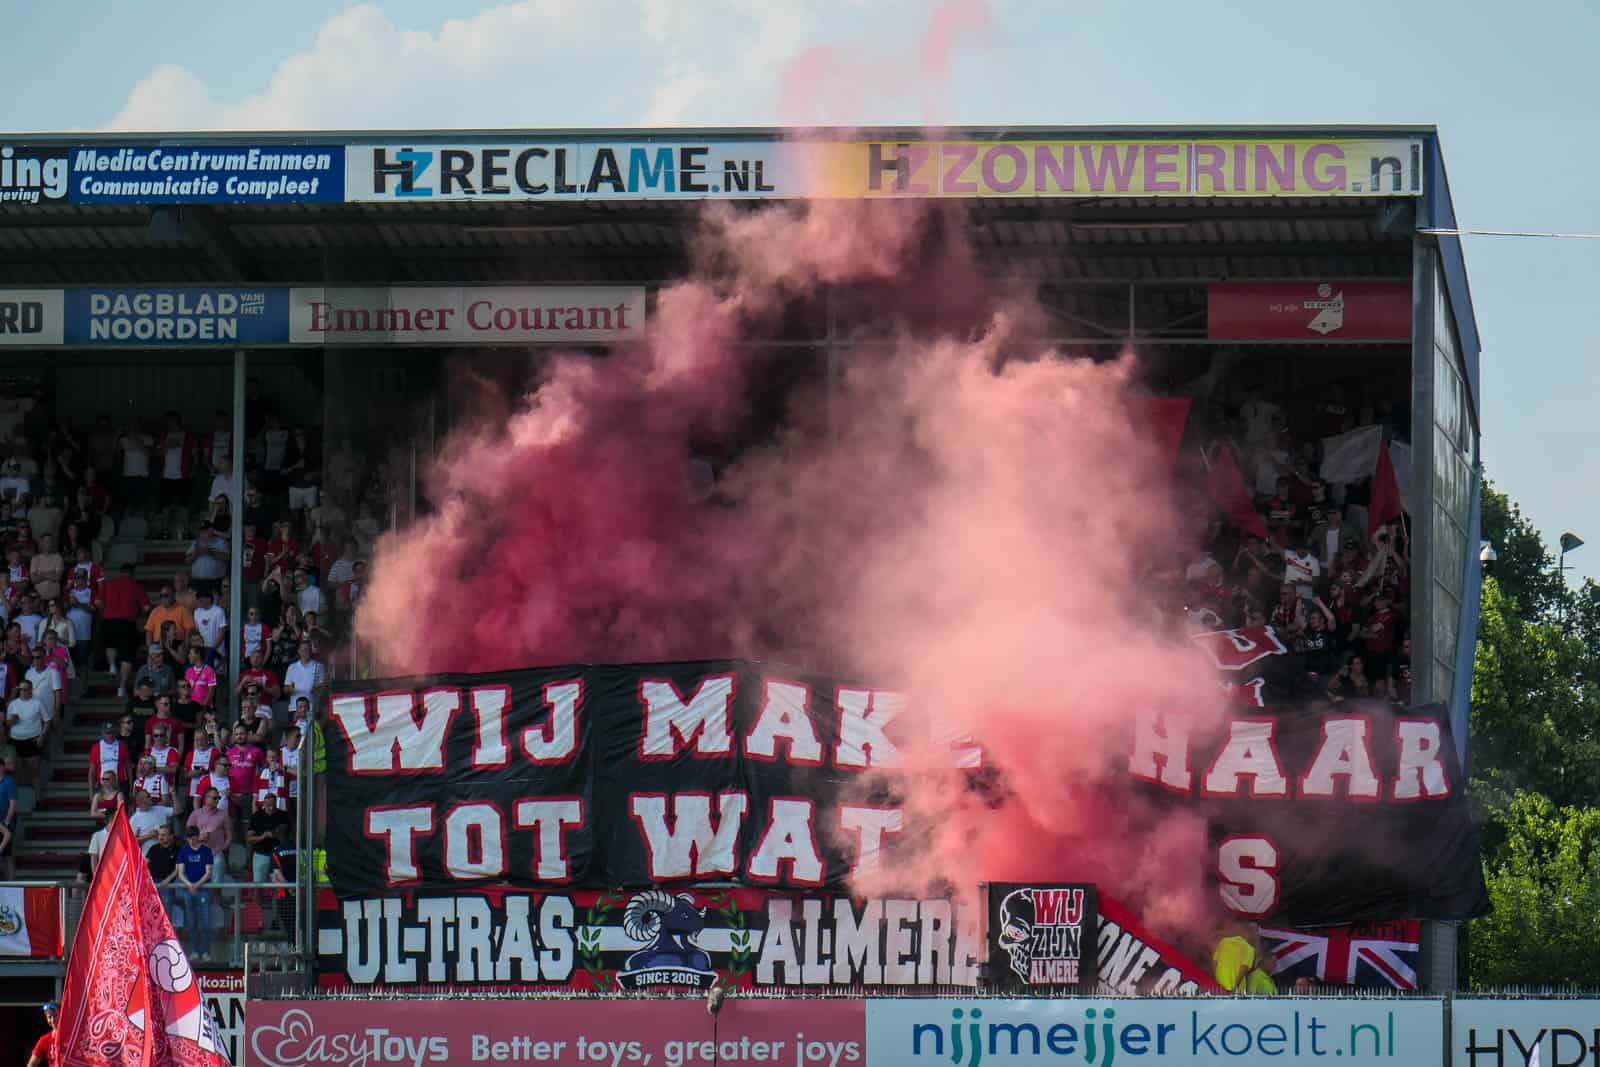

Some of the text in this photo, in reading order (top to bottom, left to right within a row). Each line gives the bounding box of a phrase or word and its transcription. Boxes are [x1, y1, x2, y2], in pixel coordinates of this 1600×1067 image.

[0, 145, 68, 199] ing
[74, 149, 331, 172] MediaCentrumEmmen
[80, 176, 319, 199] Communicatie Compleet
[90, 294, 237, 315] DAGBLAD
[308, 301, 632, 332] Emmer Courant
[90, 318, 237, 339] NOORDEN
[331, 679, 585, 775] WIJ
[1128, 710, 1452, 801] HAAR
[364, 796, 584, 886] TOT
[629, 789, 902, 887] WAT
[1031, 889, 1084, 926] WIJ
[343, 895, 575, 984] ULTRAS
[1031, 926, 1081, 959] ZIJN
[199, 975, 245, 991] kozijn
[635, 971, 700, 986] SINCE 2005
[1029, 959, 1080, 984] ALMERE
[471, 1034, 566, 1061] Better
[577, 1036, 653, 1067] toys,
[664, 1036, 785, 1067] greater
[796, 1032, 860, 1067] joys
